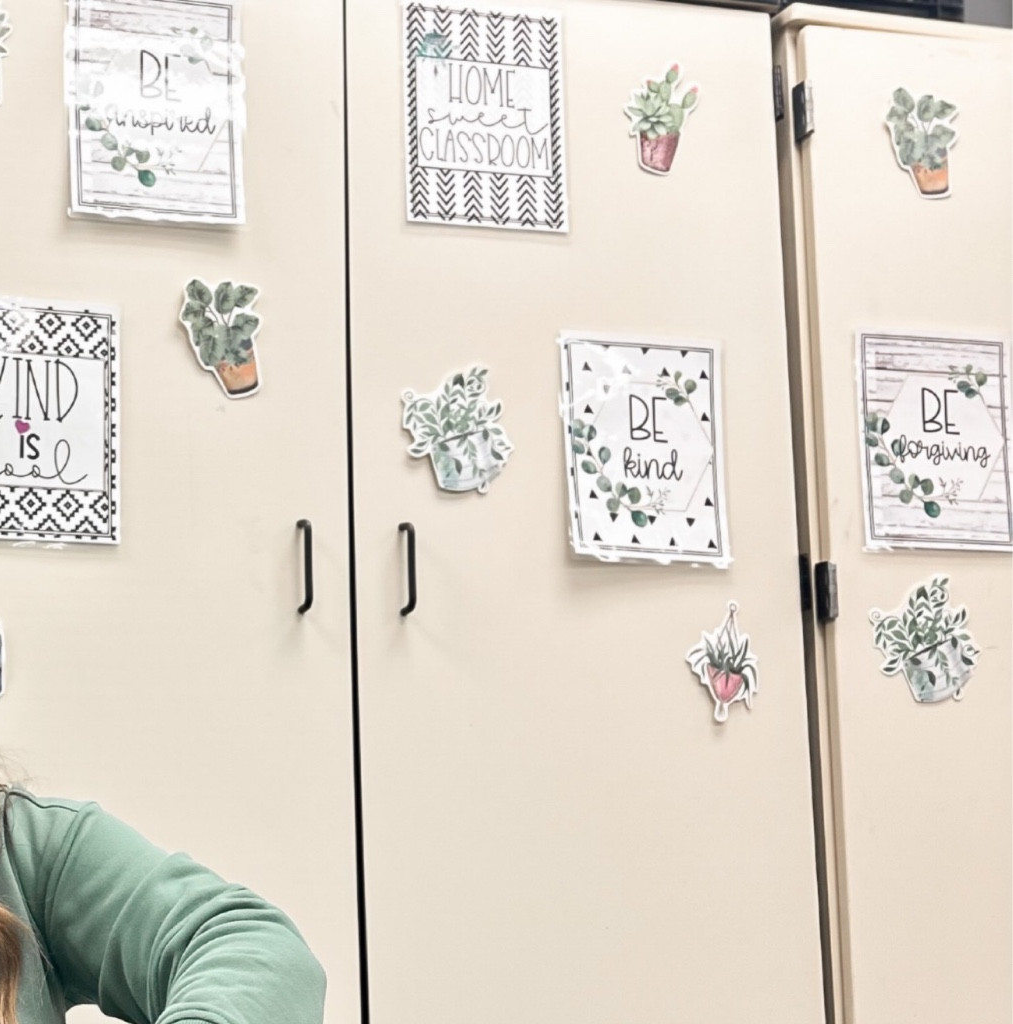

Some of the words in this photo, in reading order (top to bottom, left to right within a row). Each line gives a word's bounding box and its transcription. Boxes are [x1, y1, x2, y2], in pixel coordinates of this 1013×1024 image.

[139, 49, 182, 102] BE
[448, 62, 516, 109] HOME
[427, 107, 549, 136] sweet
[419, 126, 550, 171] CLASSROOM
[628, 393, 669, 444] BE
[921, 387, 961, 436] BE
[623, 446, 684, 482] kind
[898, 434, 992, 469] forgiving
